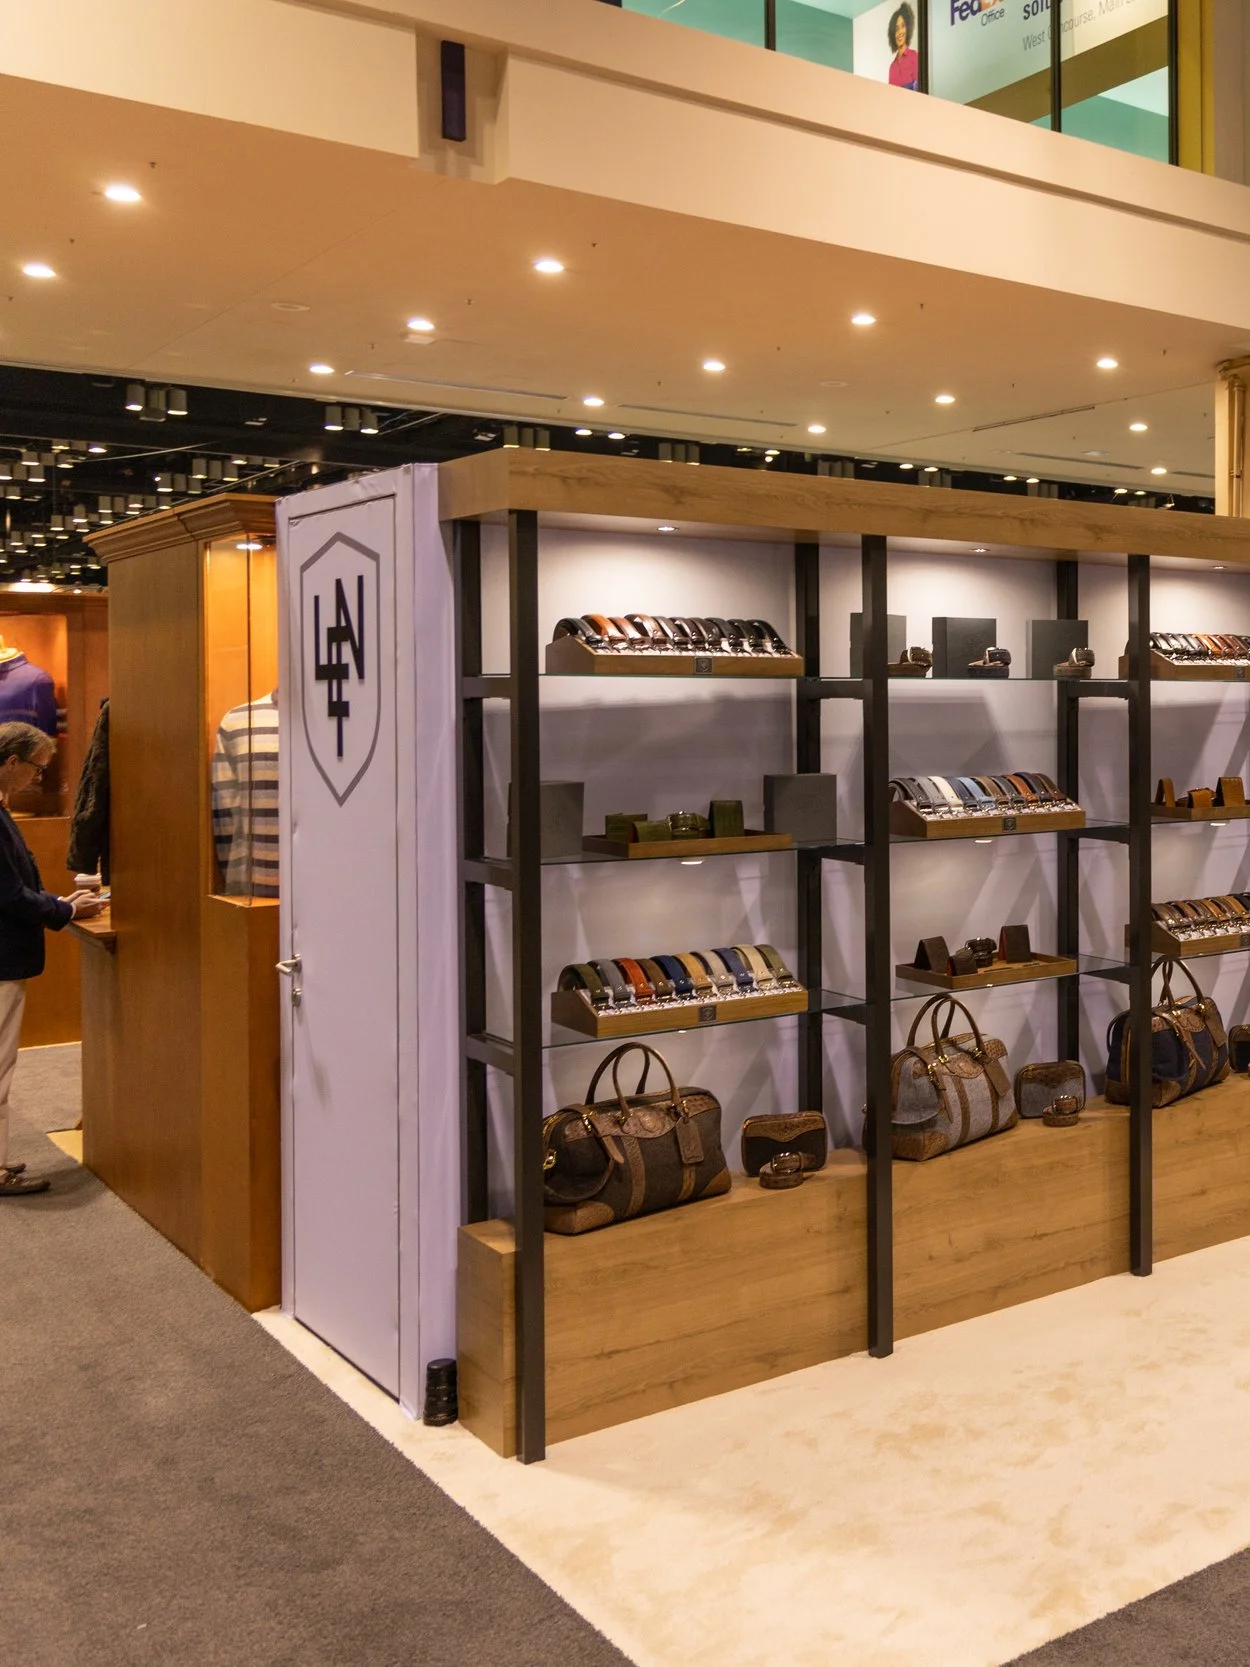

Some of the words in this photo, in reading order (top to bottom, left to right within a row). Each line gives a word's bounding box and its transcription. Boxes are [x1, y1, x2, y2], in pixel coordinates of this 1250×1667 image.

[981, 8, 1005, 26] Office
[1022, 31, 1045, 51] West
[1048, 10, 1096, 41] ncourse,
